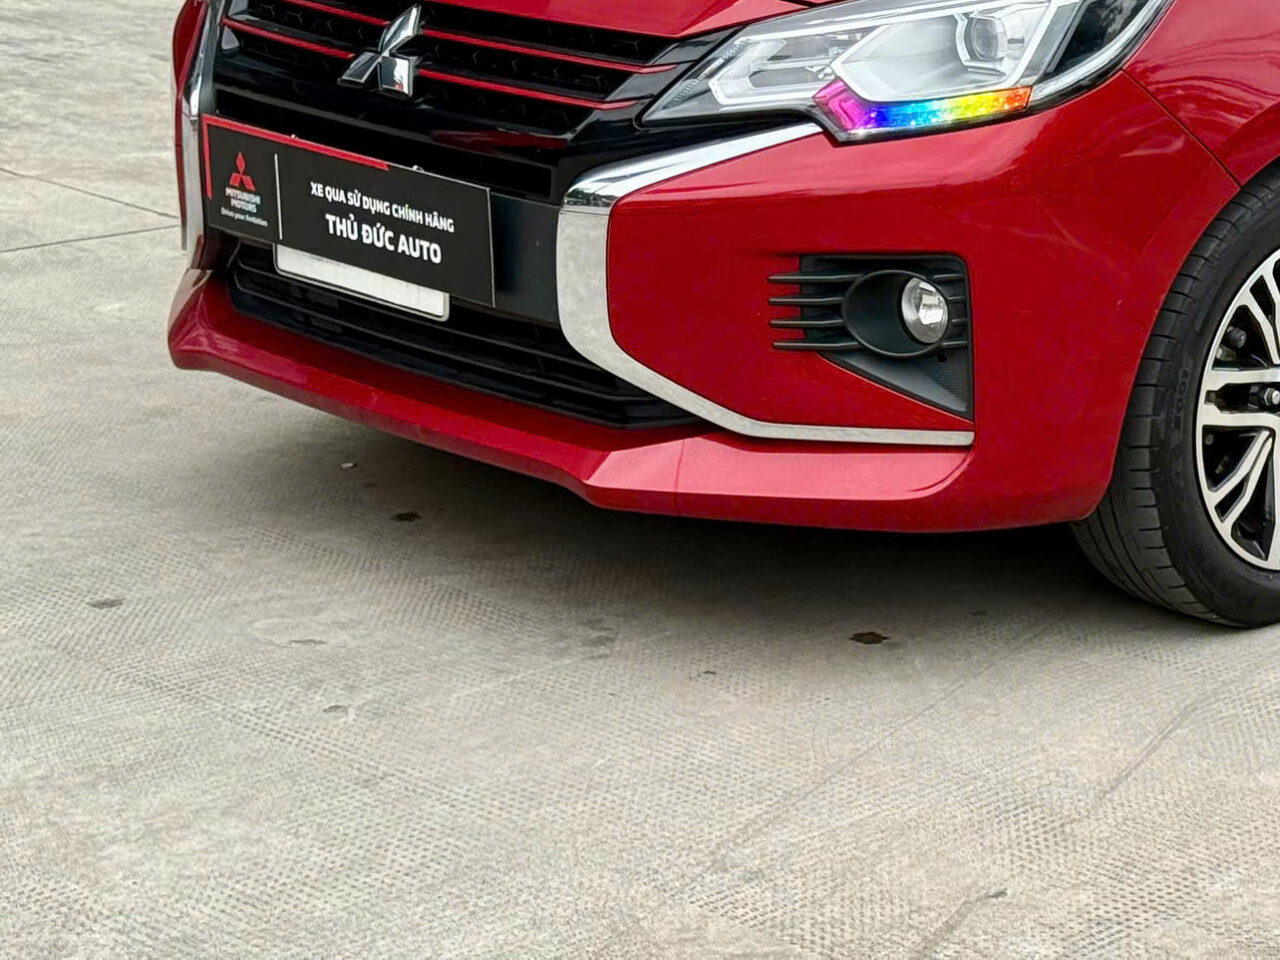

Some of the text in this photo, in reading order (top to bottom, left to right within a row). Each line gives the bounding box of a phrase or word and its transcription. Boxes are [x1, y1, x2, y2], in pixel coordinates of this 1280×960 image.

[231, 198, 257, 213] MOTORS
[310, 181, 324, 197] XE
[325, 186, 347, 203] QUA
[362, 196, 391, 215] DỤNG
[392, 204, 424, 225] CHÍNH
[425, 211, 455, 233] HÃNG
[325, 213, 442, 264] THỦ ĐỨC AUTO
